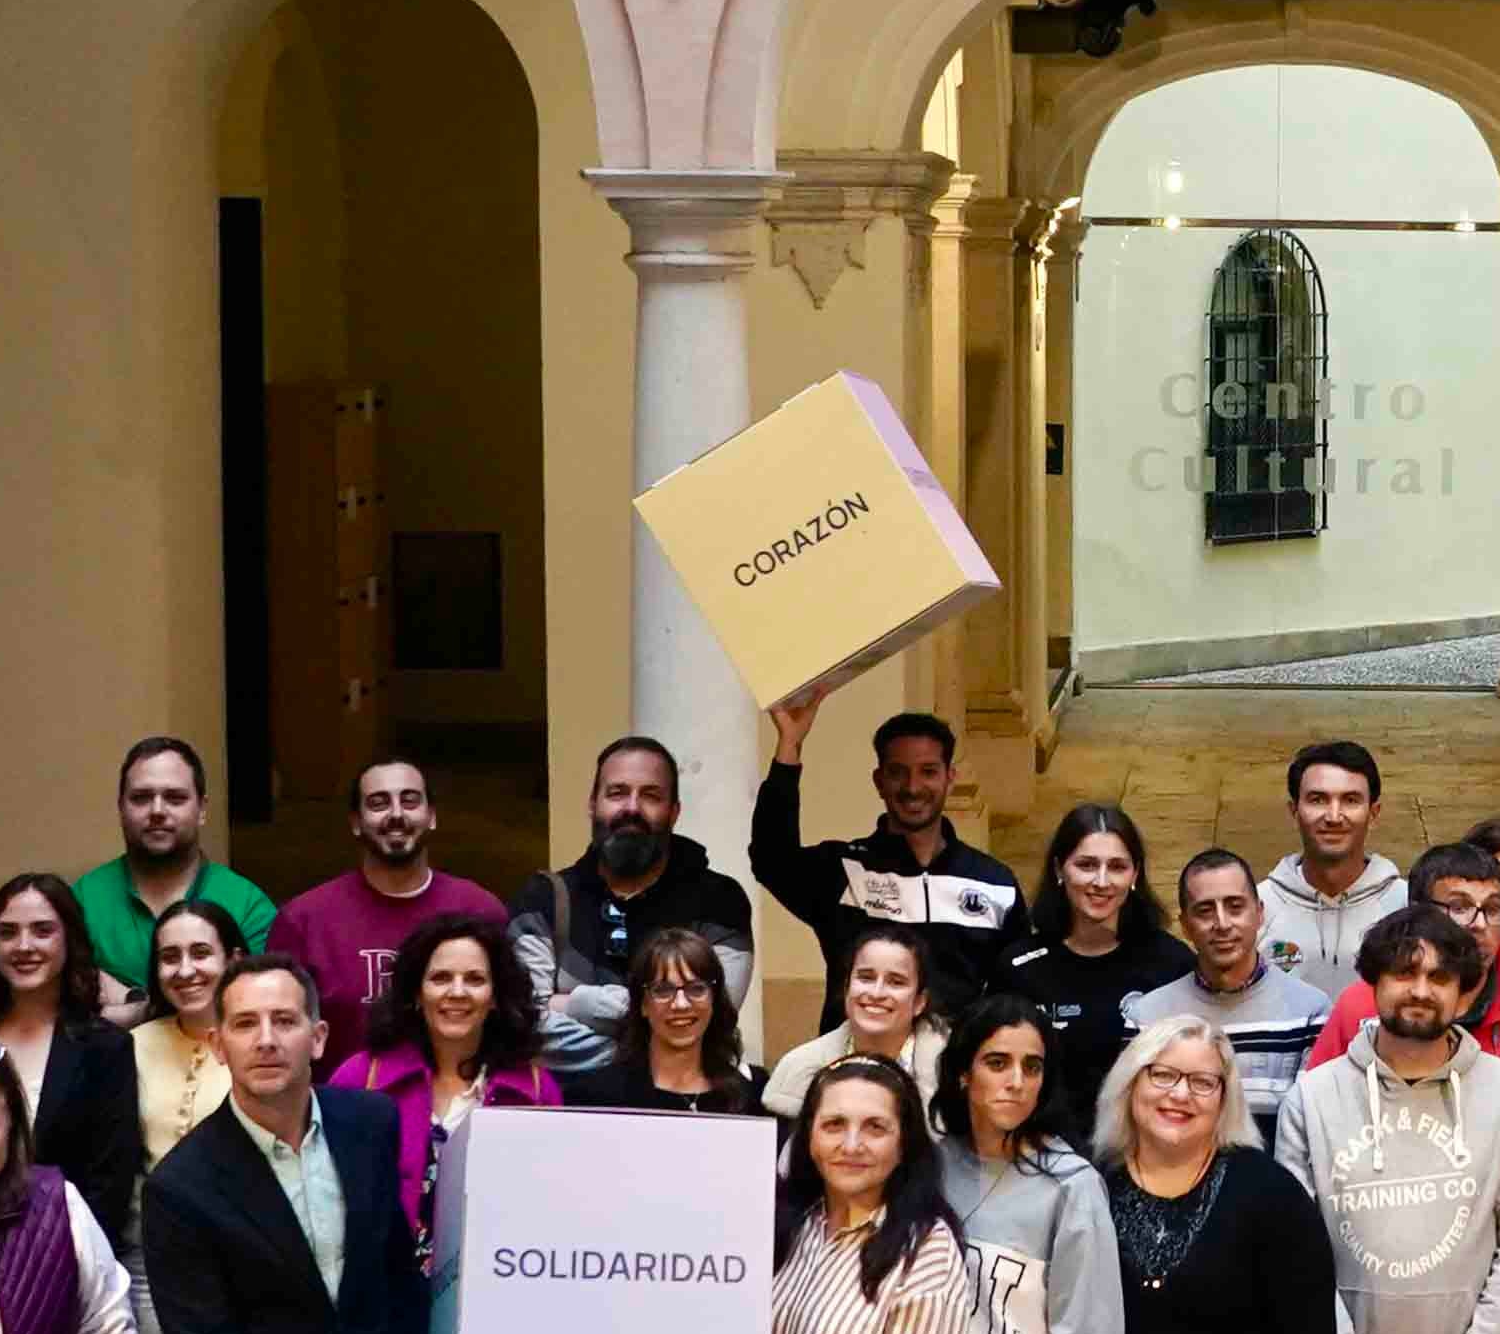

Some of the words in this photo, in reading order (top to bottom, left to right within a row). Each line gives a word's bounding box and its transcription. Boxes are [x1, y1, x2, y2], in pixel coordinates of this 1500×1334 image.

[1159, 371, 1427, 421] Centro
[1129, 443, 1455, 496] Cultural
[733, 491, 870, 587] CORAZÓN
[1328, 1181, 1437, 1212] TRAINING
[493, 1247, 747, 1284] SOLIDARIDAD
[1387, 1206, 1471, 1279] GUARANTEED
